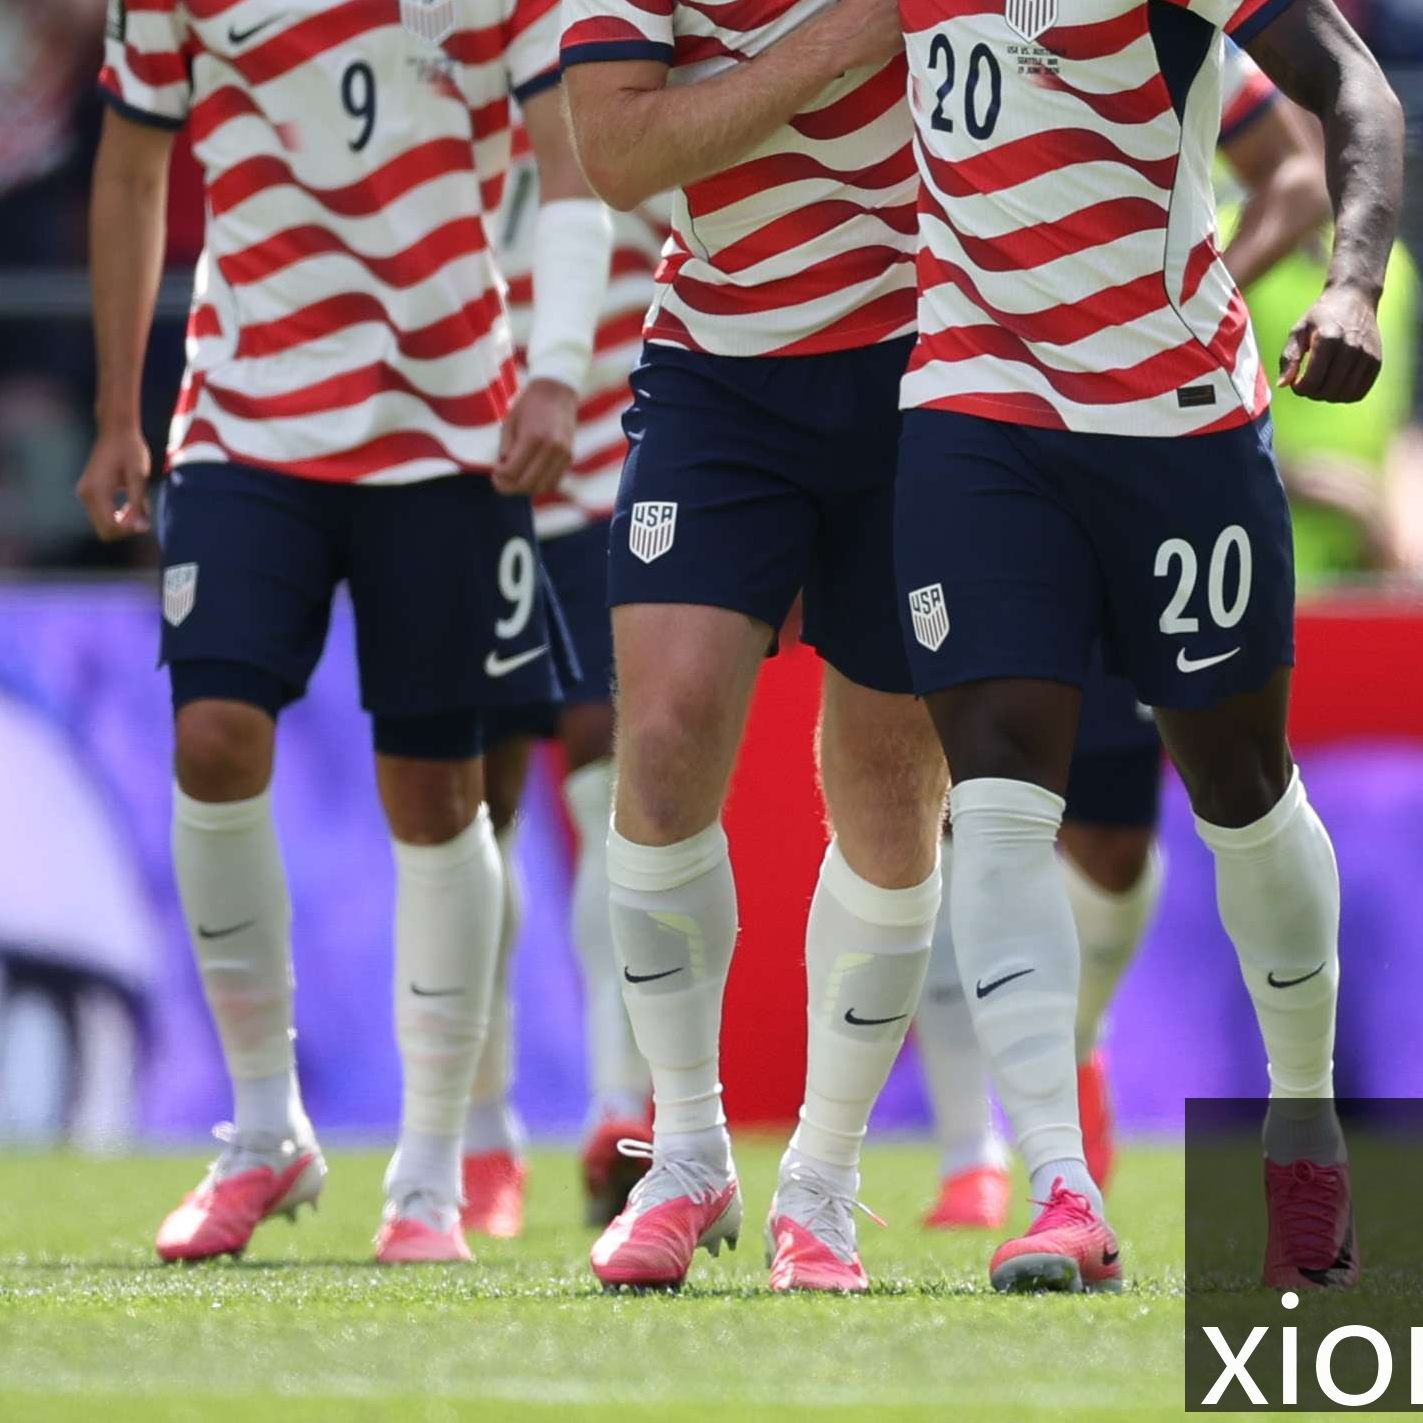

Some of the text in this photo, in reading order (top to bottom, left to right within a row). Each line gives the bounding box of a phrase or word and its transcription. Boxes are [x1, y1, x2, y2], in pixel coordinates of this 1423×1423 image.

[342, 61, 375, 152] 9
[928, 33, 1001, 140] 20
[634, 505, 674, 528] USA
[495, 537, 534, 639] 9
[911, 587, 941, 615] USA
[1154, 525, 1252, 634] 20
